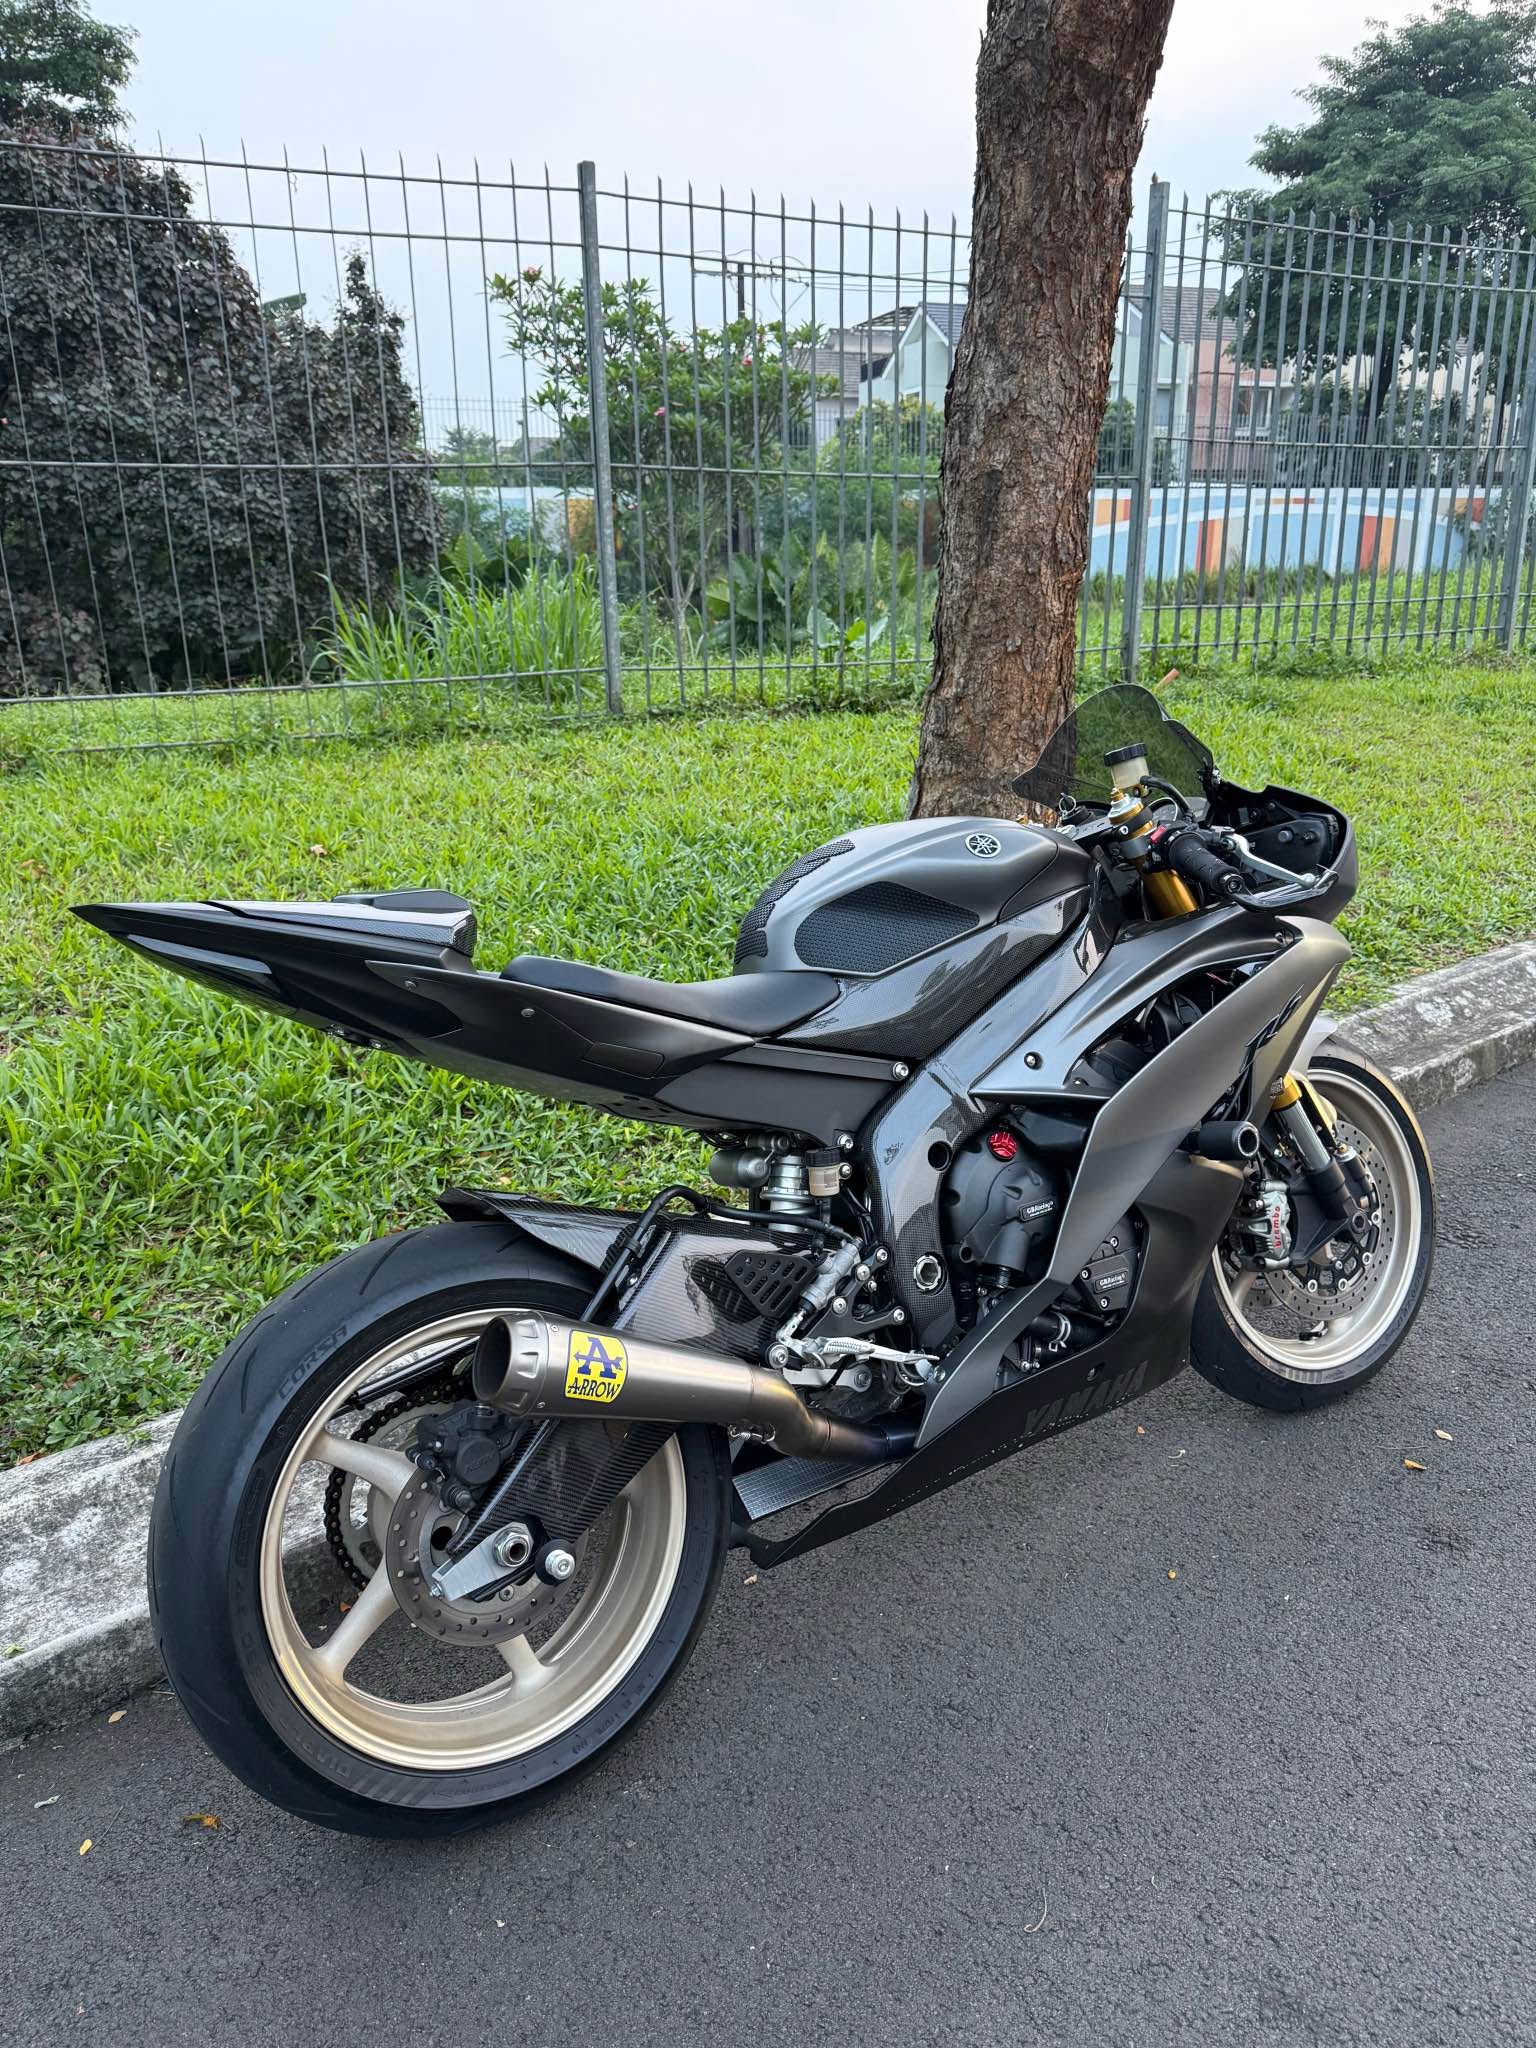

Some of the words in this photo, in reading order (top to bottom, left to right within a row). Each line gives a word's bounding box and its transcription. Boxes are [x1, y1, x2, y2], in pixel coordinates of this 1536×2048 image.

[1272, 1206, 1281, 1248] brembo
[278, 1325, 348, 1399] CORSA
[567, 1377, 620, 1399] ARROW
